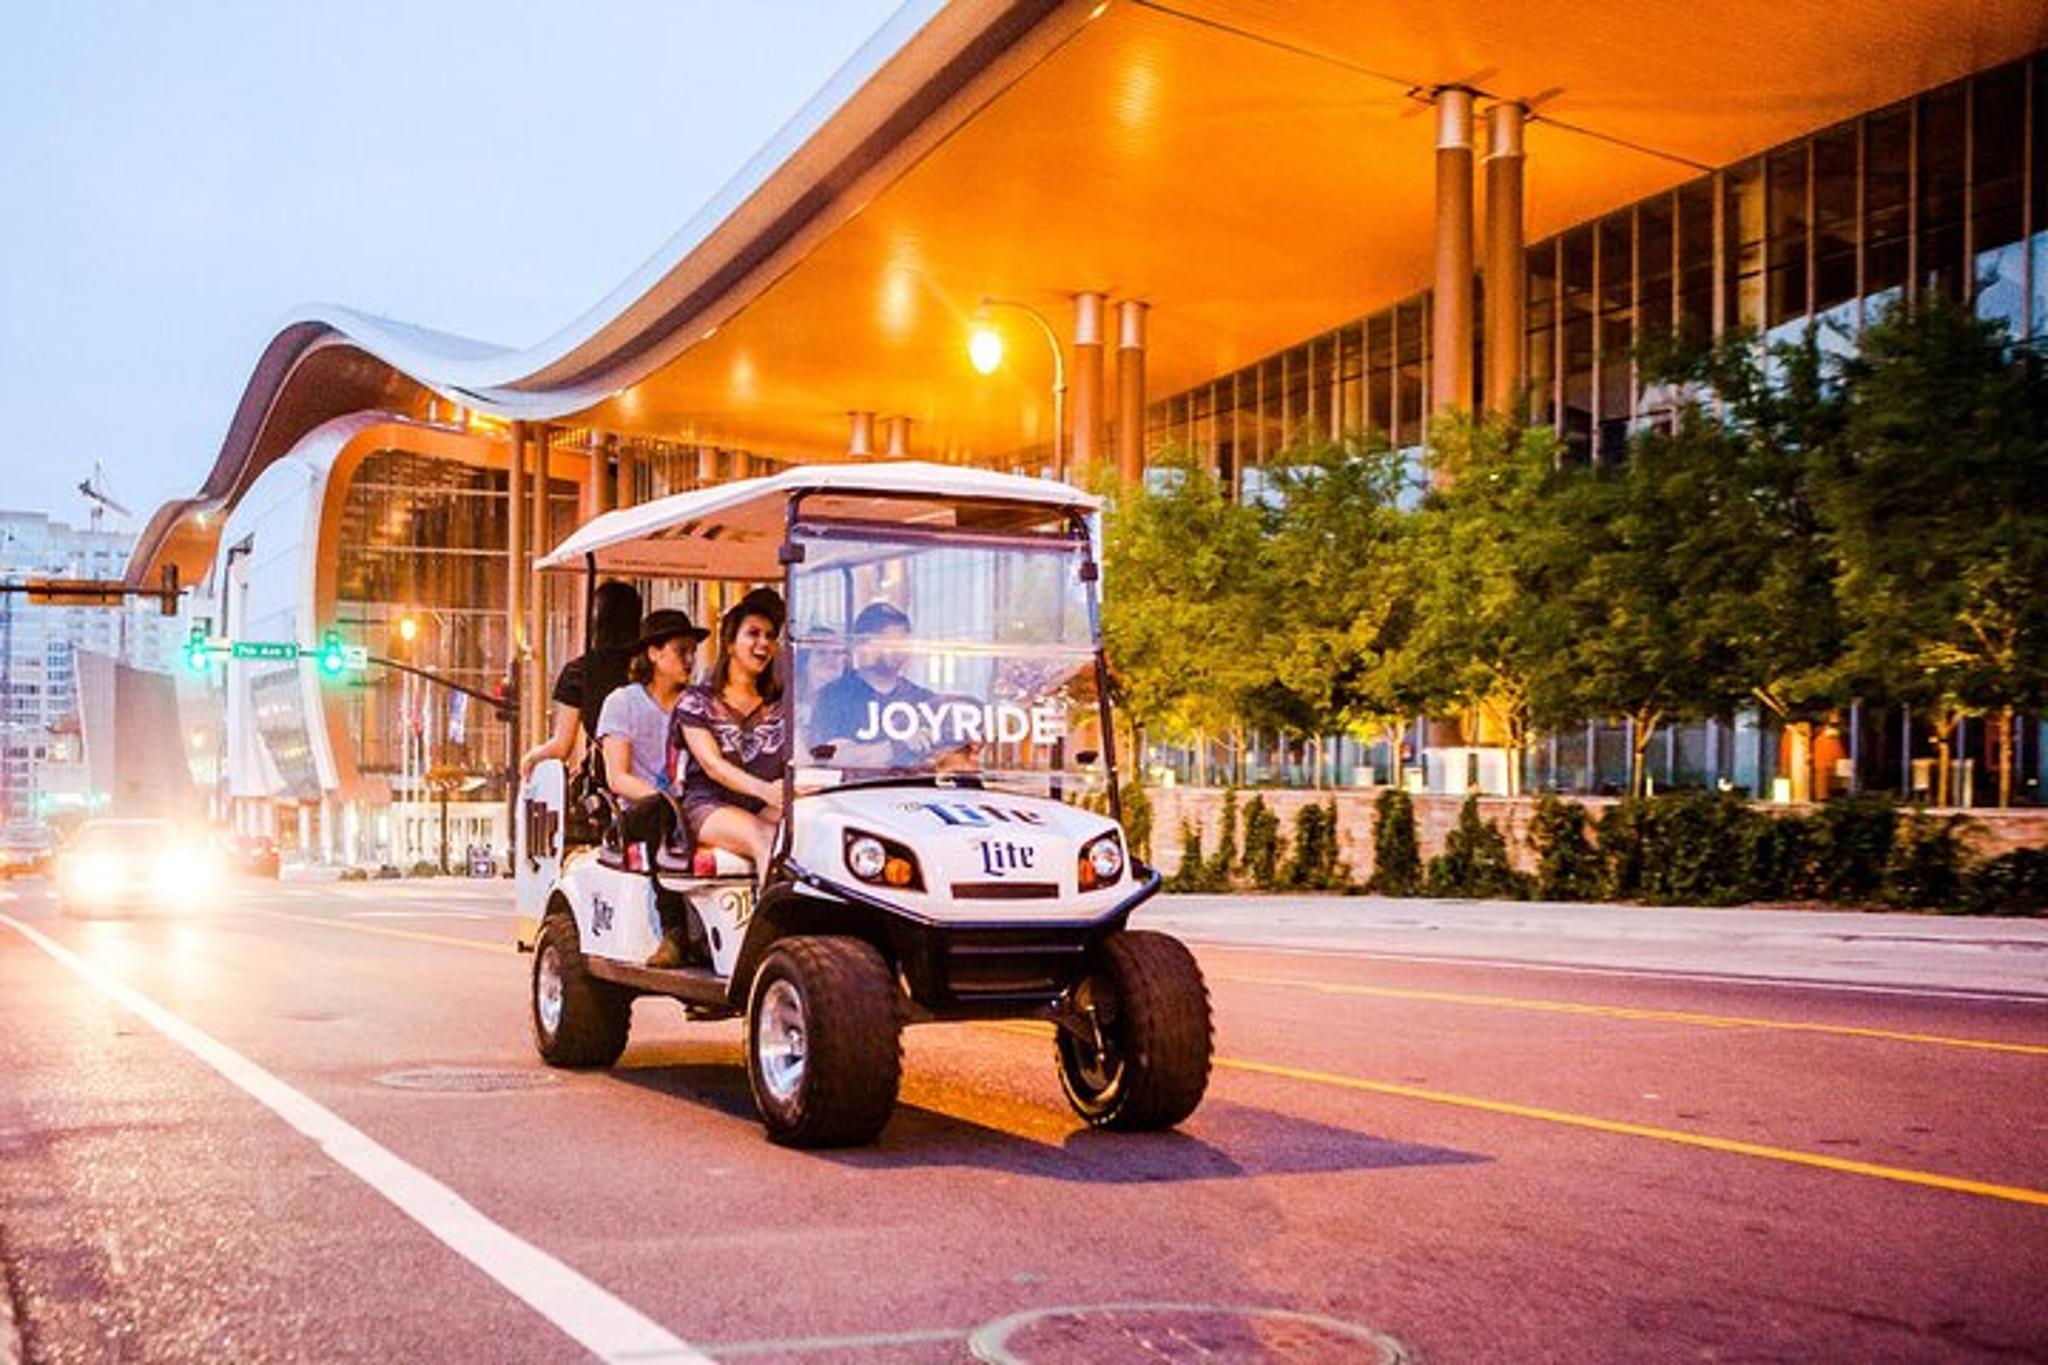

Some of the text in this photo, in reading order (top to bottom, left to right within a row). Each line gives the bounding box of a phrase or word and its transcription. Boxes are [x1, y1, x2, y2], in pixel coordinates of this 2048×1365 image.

[856, 701, 1060, 743] JOYRIDE
[921, 804, 1043, 828] Lite
[980, 841, 1034, 876] Lite
